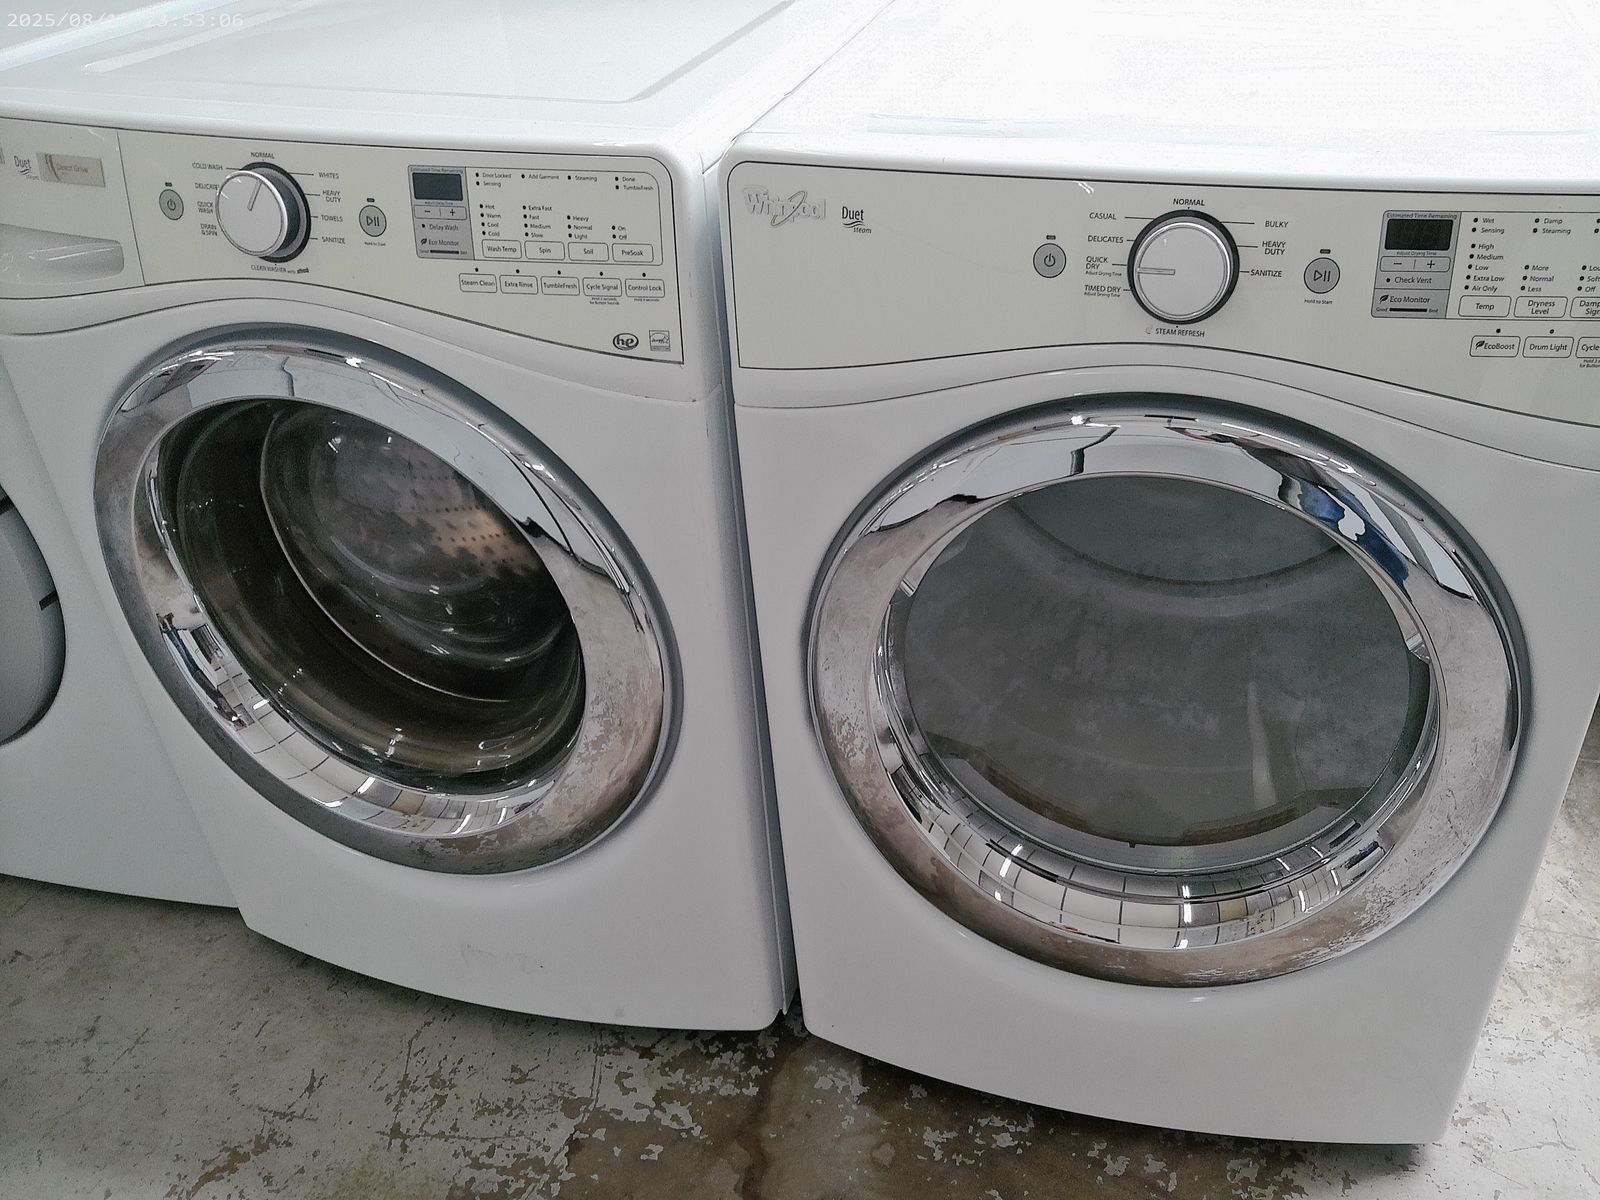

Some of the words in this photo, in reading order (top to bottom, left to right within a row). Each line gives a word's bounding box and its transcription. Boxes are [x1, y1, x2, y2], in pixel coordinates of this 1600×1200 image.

[250, 151, 275, 160] NORMAL
[13, 155, 31, 169] Duet
[191, 161, 207, 170] COLD
[208, 163, 223, 171] WASH
[318, 172, 340, 180] WHITES
[196, 200, 213, 208] QUICK
[1172, 198, 1206, 207] NORMAL
[841, 206, 864, 221] Duet
[1089, 212, 1117, 220] CASUAL
[320, 214, 344, 222] TOWELS
[429, 223, 443, 231] Delay
[1264, 220, 1289, 228] BULKY
[1480, 227, 1505, 235] Sensing
[321, 236, 346, 244] SANITIZE
[1087, 235, 1124, 243] DELICATES
[1261, 240, 1287, 248] HEAVY
[538, 246, 552, 254] Spin
[621, 249, 644, 257] PreSoak
[1085, 255, 1109, 263] QUICK
[1250, 268, 1282, 277] SANITIZE
[1394, 276, 1414, 284] Check
[543, 281, 578, 289] TumbleFresh
[586, 283, 600, 291] Cycle
[601, 283, 618, 292] Signal
[649, 284, 662, 292] Lock
[1084, 284, 1106, 292] TIMED
[1107, 285, 1121, 293] DRY
[1482, 285, 1498, 293] Only
[1475, 302, 1495, 311] Temp
[1527, 300, 1556, 308] Dryness
[1530, 307, 1550, 315] Level
[1155, 327, 1177, 336] STEAM
[1177, 329, 1205, 338] REFRESH
[1483, 342, 1515, 350] EcoBoost
[1529, 343, 1549, 351] Drum
[1549, 343, 1568, 352] Light
[1581, 344, 1600, 352] Cycle
